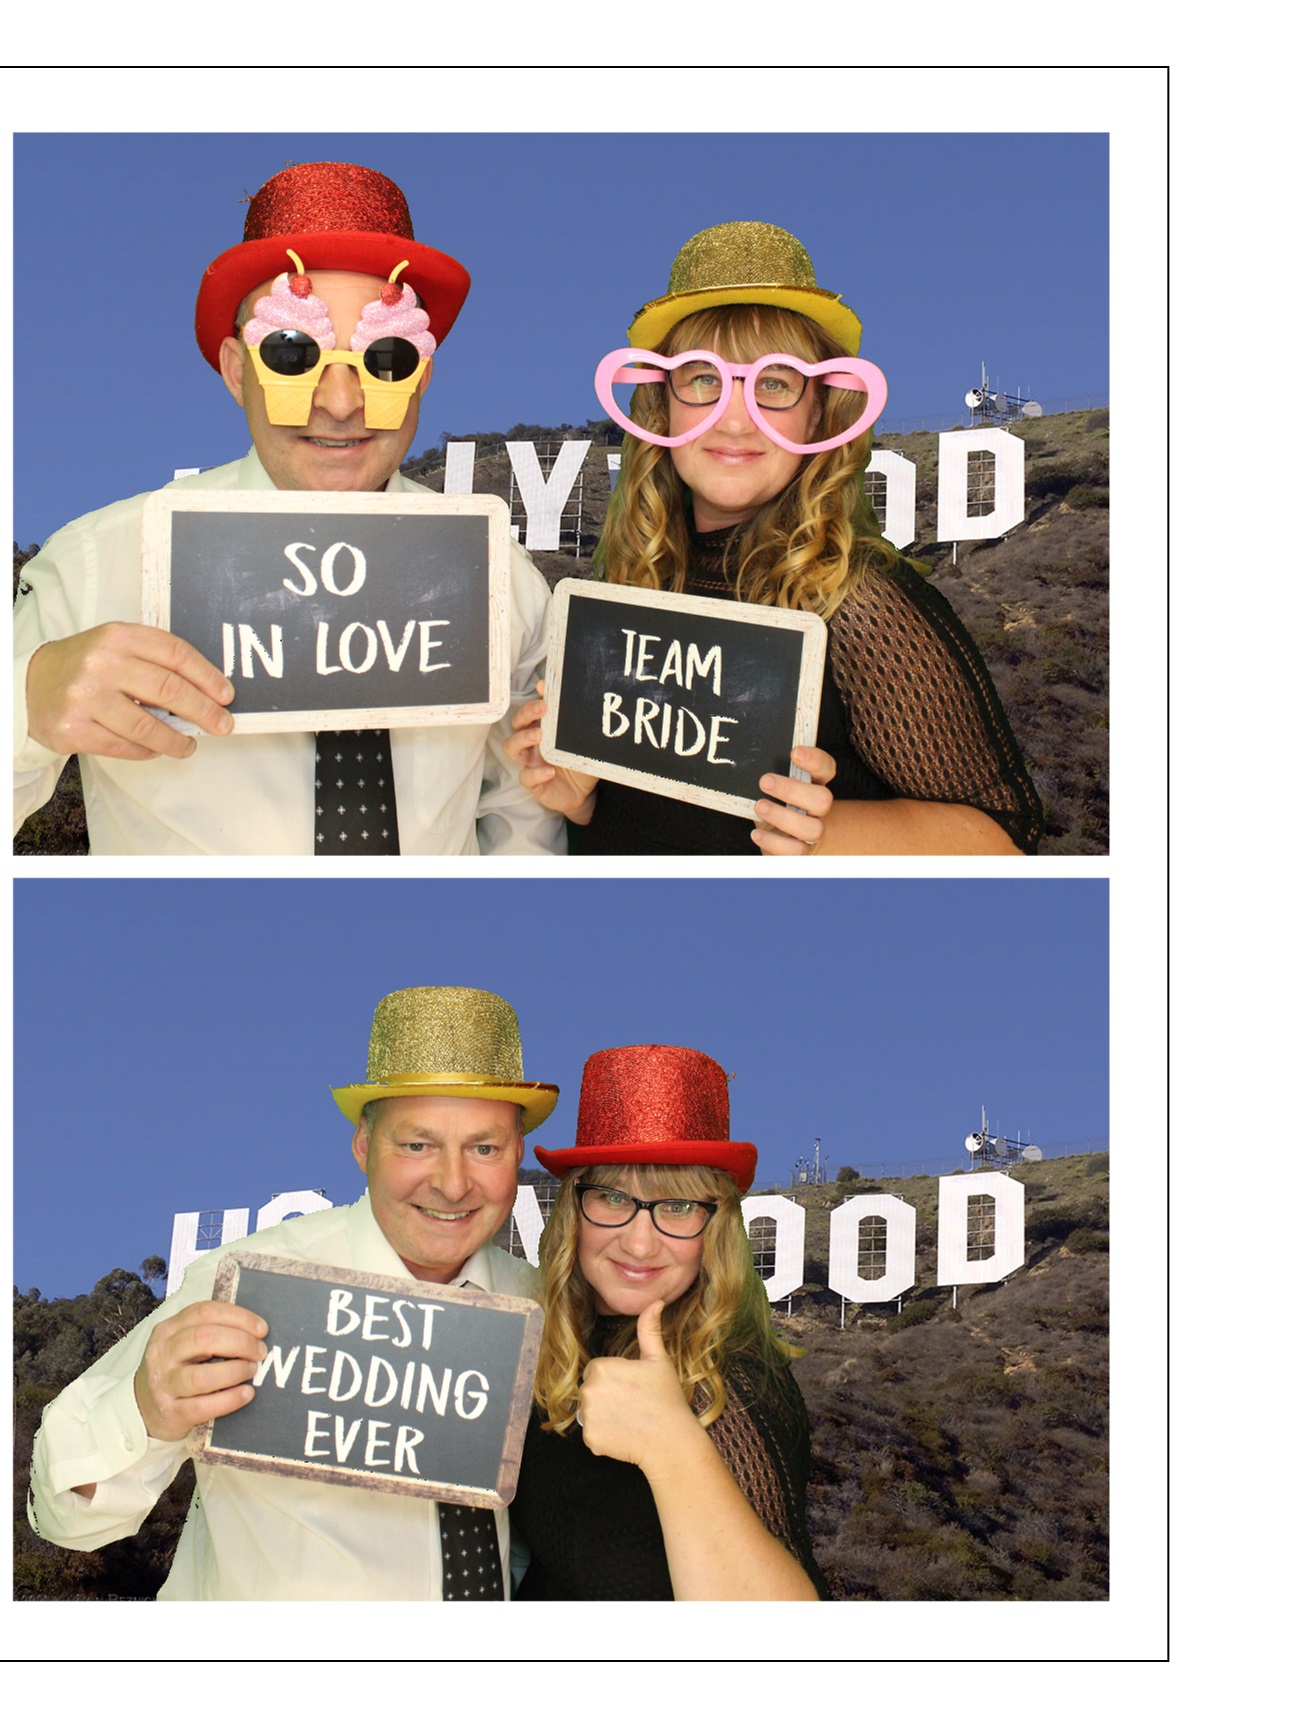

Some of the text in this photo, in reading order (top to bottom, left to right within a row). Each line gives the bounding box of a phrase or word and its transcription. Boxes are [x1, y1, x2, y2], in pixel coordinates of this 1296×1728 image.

[283, 541, 367, 597] SO
[222, 619, 452, 679] IN LOVE
[621, 628, 723, 697] TEAM
[601, 692, 740, 766] BRIDE
[326, 1288, 445, 1351] BEST
[252, 1344, 490, 1421] WEDDING
[303, 1410, 425, 1475] EVER
